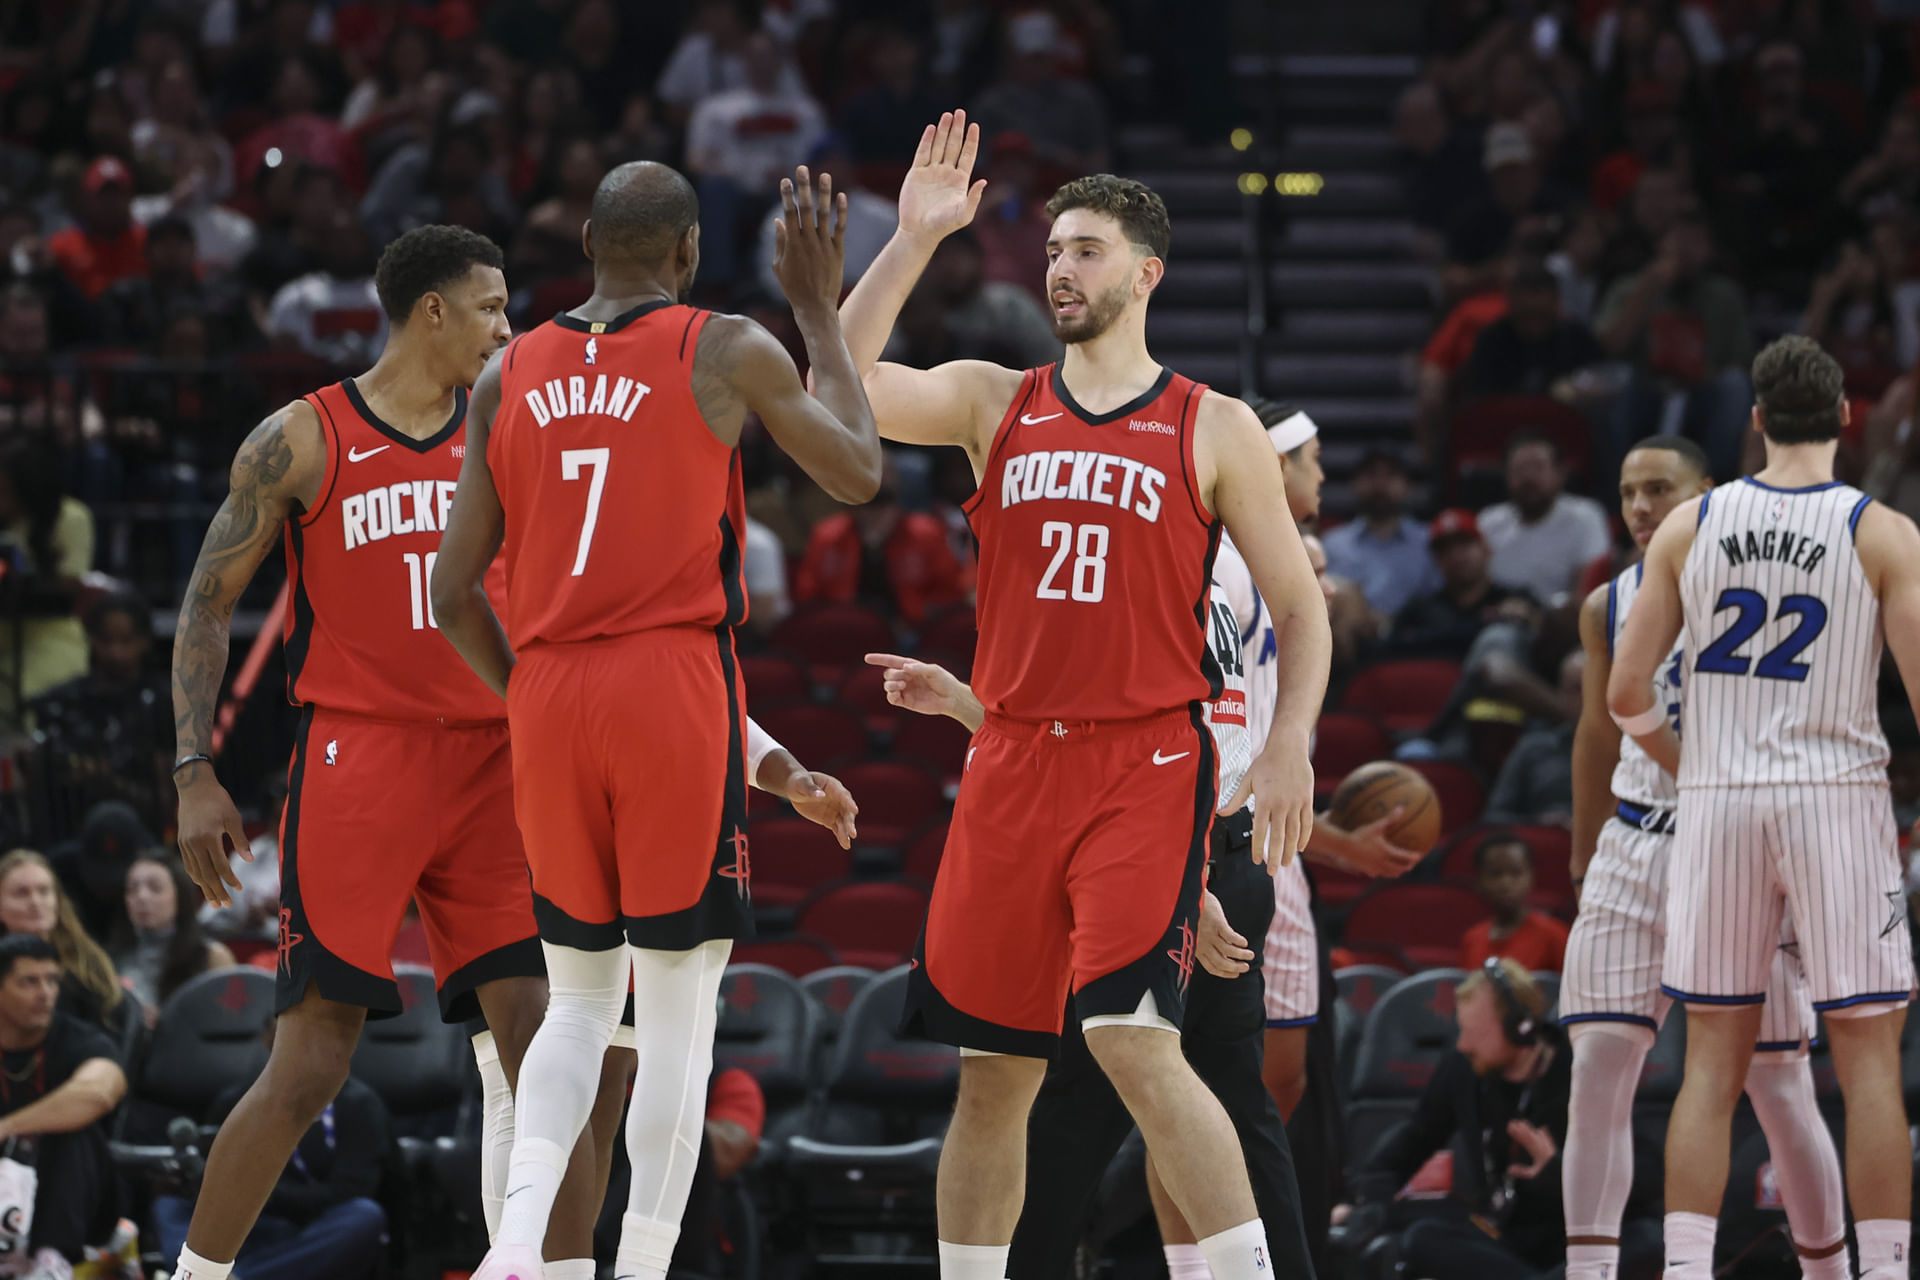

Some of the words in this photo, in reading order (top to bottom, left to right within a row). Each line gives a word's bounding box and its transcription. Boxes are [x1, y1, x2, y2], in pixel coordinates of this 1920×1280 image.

[525, 374, 652, 428] DURANT
[342, 479, 458, 552] ROCKE
[561, 447, 610, 577] 7
[1002, 451, 1167, 523] ROCKETS
[1036, 521, 1110, 603] 28
[1719, 529, 1827, 575] WAGNER
[1694, 587, 1828, 682] 22
